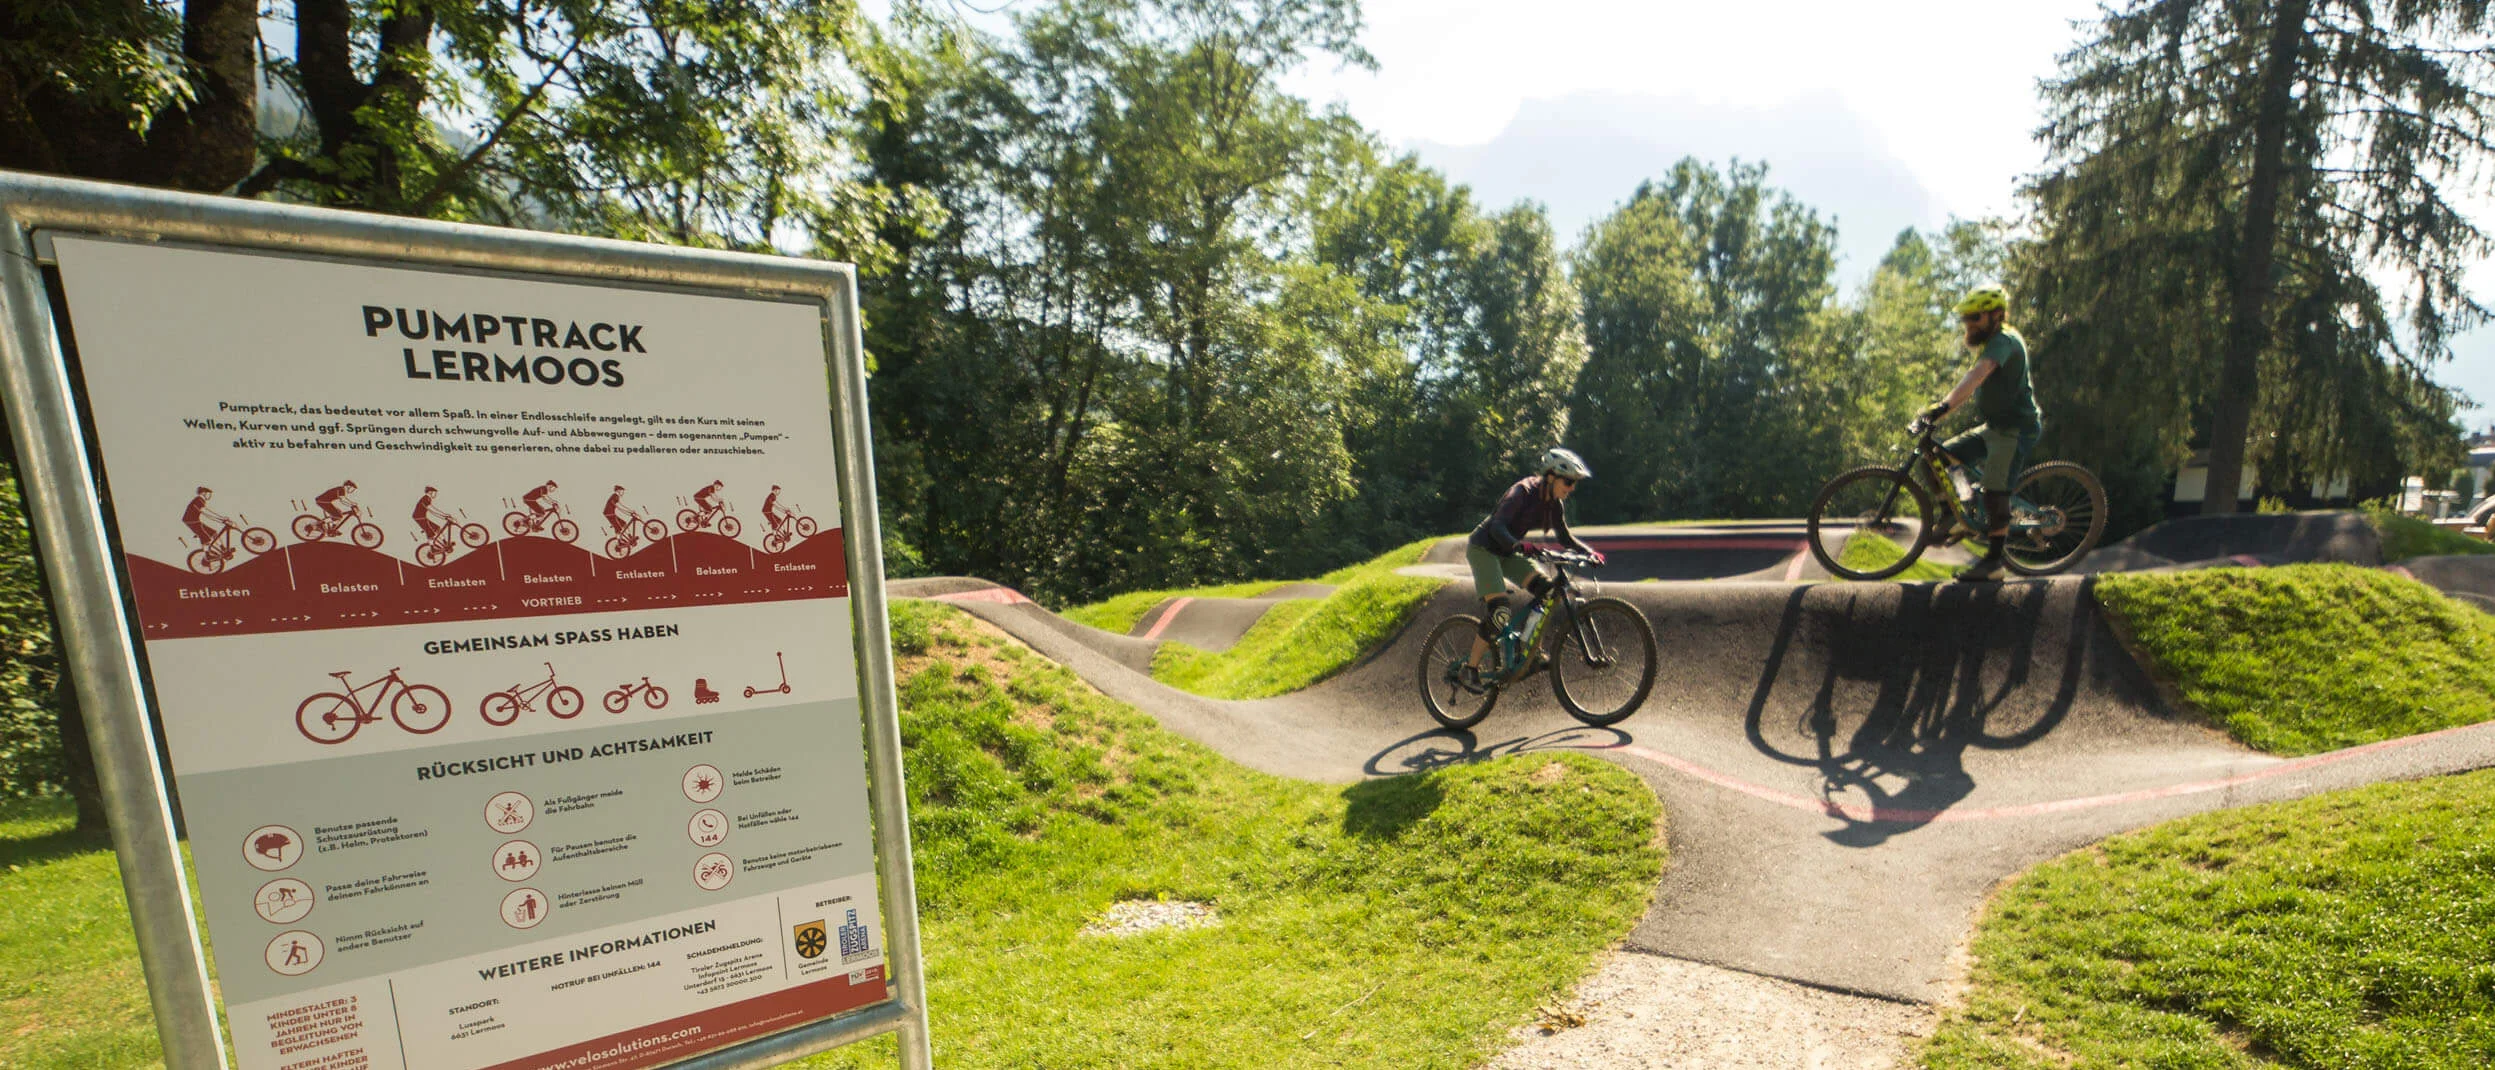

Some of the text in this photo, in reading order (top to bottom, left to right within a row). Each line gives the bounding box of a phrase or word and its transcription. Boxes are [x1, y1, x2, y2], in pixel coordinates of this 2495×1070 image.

[362, 305, 647, 353] PUMPTRACK
[403, 348, 624, 388] LERMOOS
[218, 401, 297, 415] Pumptrack,
[300, 404, 321, 415] das
[325, 405, 382, 416] bedeutet
[386, 409, 404, 417] vor
[408, 408, 439, 418] allem
[442, 409, 475, 420] Spaß.
[476, 410, 487, 419] In
[490, 411, 518, 420] einer
[521, 411, 597, 422] Endlosschleife
[599, 414, 645, 425] angelegt,
[647, 415, 663, 426] gilt
[678, 416, 695, 425] den
[697, 417, 718, 425] Kurs
[720, 417, 735, 426] mit
[736, 418, 765, 427] seinen
[183, 419, 237, 431] Wellen,
[239, 420, 287, 431] Kurven
[291, 422, 315, 432] und
[318, 422, 344, 434] ggf.
[346, 423, 406, 435] Sprüngen
[409, 425, 442, 434] durch
[445, 425, 519, 437] schwungvolle
[522, 427, 545, 436] Auf-
[547, 428, 567, 437] und
[570, 428, 647, 440] Abbewegungen
[656, 431, 677, 439] dem
[679, 432, 737, 442] sogenannten
[232, 438, 266, 449] aktiv
[269, 441, 284, 449] zu
[287, 439, 346, 450] befahren
[349, 441, 372, 450] und
[375, 441, 473, 453] Geschwindigkeit
[475, 444, 488, 452] zu
[490, 443, 553, 454] generieren,
[555, 444, 581, 453] ohne
[583, 444, 611, 453] dabei
[626, 445, 677, 456] pedalieren
[679, 446, 700, 455] oder
[703, 446, 765, 455] anzuschieben.
[524, 573, 573, 584] Belasten
[616, 569, 665, 580] Entlasten
[696, 566, 738, 576] Belasten
[774, 562, 816, 572] Entlasten
[179, 586, 251, 600] Entlasten
[320, 582, 379, 594] Belasten
[428, 578, 486, 588] Entlasten
[521, 596, 582, 608] VORTRIEB
[424, 624, 679, 655] GEMEINSAM SPASS HABEN
[416, 731, 714, 781] RÜCKSICHT UND ACHTSAMKEIT
[700, 834, 718, 843] 144
[848, 910, 859, 952] ZUGSPITZ
[479, 919, 716, 981] WEITERE INFORMATIONEN
[551, 977, 586, 991] NOTRUF
[587, 974, 601, 983] BEI
[647, 960, 661, 969] 144
[350, 995, 358, 1003] 3
[270, 1015, 311, 1030] KINDER
[313, 1006, 348, 1020] UNTER
[276, 1014, 356, 1038] JAHREN NUR IN
[271, 1021, 363, 1048] BEGLEITUNG VON
[280, 1031, 359, 1055] ERWACHSENEN
[322, 1047, 364, 1063] HAFTEN
[537, 1025, 702, 1070] ww.velosolutions.com
[330, 1055, 368, 1070] KINDER
